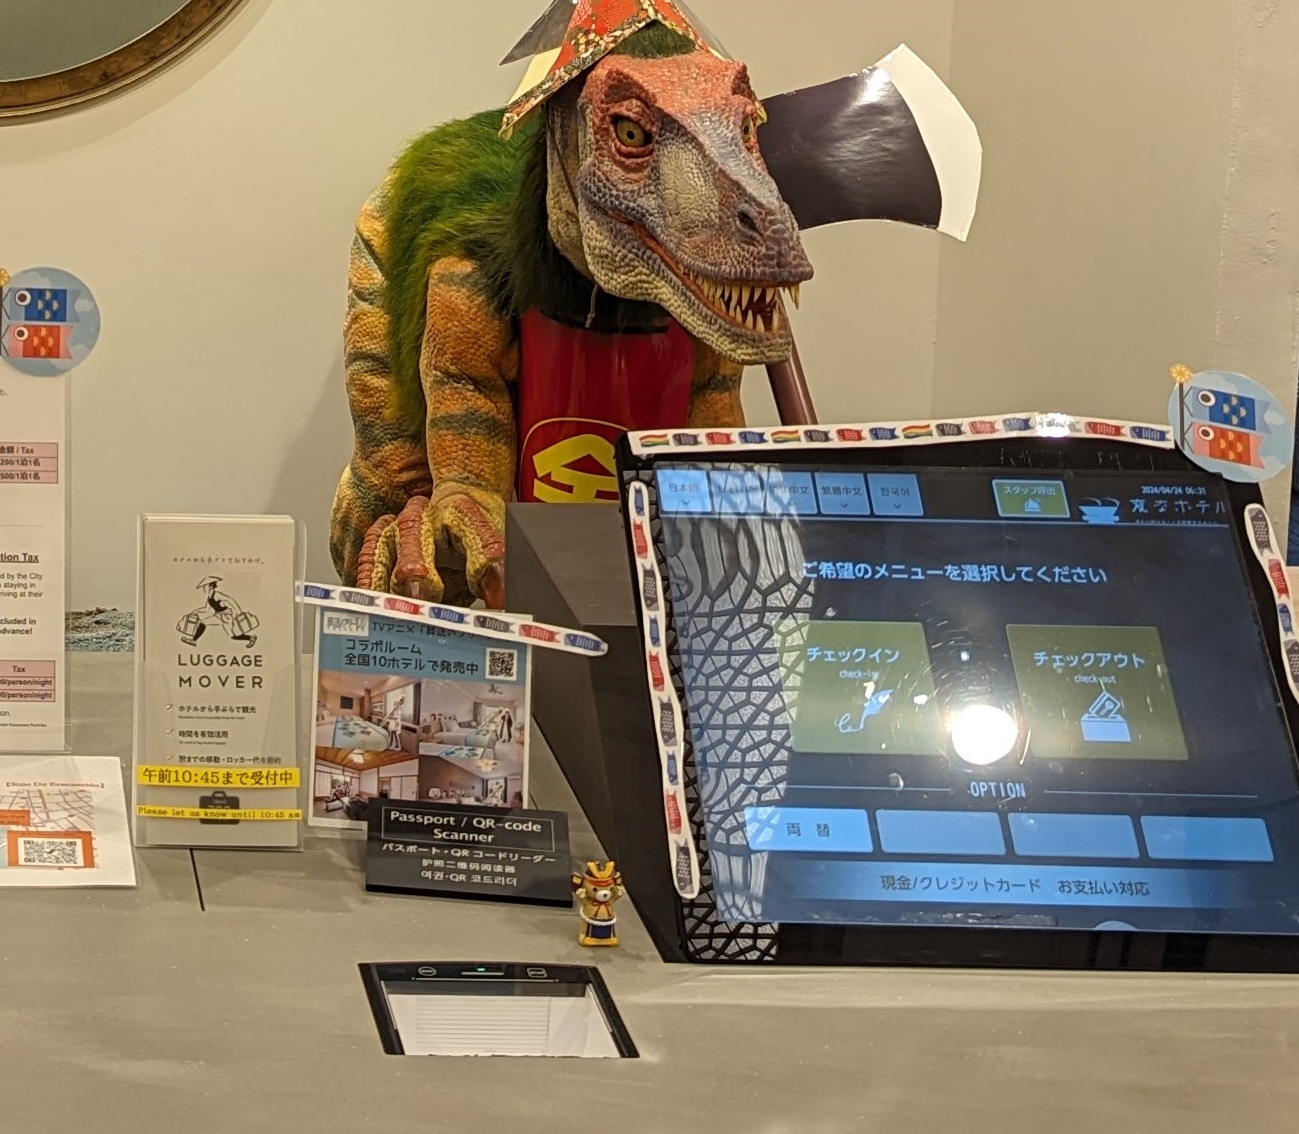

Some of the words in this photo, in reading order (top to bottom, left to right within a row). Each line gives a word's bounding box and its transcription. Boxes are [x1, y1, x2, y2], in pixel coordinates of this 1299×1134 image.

[668, 483, 698, 494] 日本語
[880, 487, 910, 497] 한국어
[1003, 486, 1056, 496] スタッフ呼出
[22, 552, 39, 562] Tax
[802, 562, 1107, 584] ご希望のメニューを選択してください
[345, 638, 422, 655] コラボルーム
[178, 654, 263, 667] LUGGAGE
[806, 647, 900, 664] チェックイン
[1034, 651, 1145, 668] チェックアウト
[344, 653, 478, 675] 全国10ホテルで発売中
[178, 675, 263, 688] MOVER
[839, 669, 879, 680] check-in
[1074, 674, 1117, 684] check-out
[178, 705, 256, 714] ホテルから手ぶらで観光
[143, 768, 293, 785] 午前10:45まで受付中
[970, 781, 1026, 798] OPTION
[138, 807, 167, 815] Please
[172, 808, 184, 816] let
[203, 809, 227, 818] know
[230, 810, 256, 818] until
[260, 811, 285, 819] 10:45
[390, 810, 456, 826] Passport
[473, 818, 542, 833] QR-code
[433, 828, 495, 843] Scanner
[880, 874, 1040, 893] 現金/クレジットカード
[1058, 880, 1151, 897] お支払い対応
